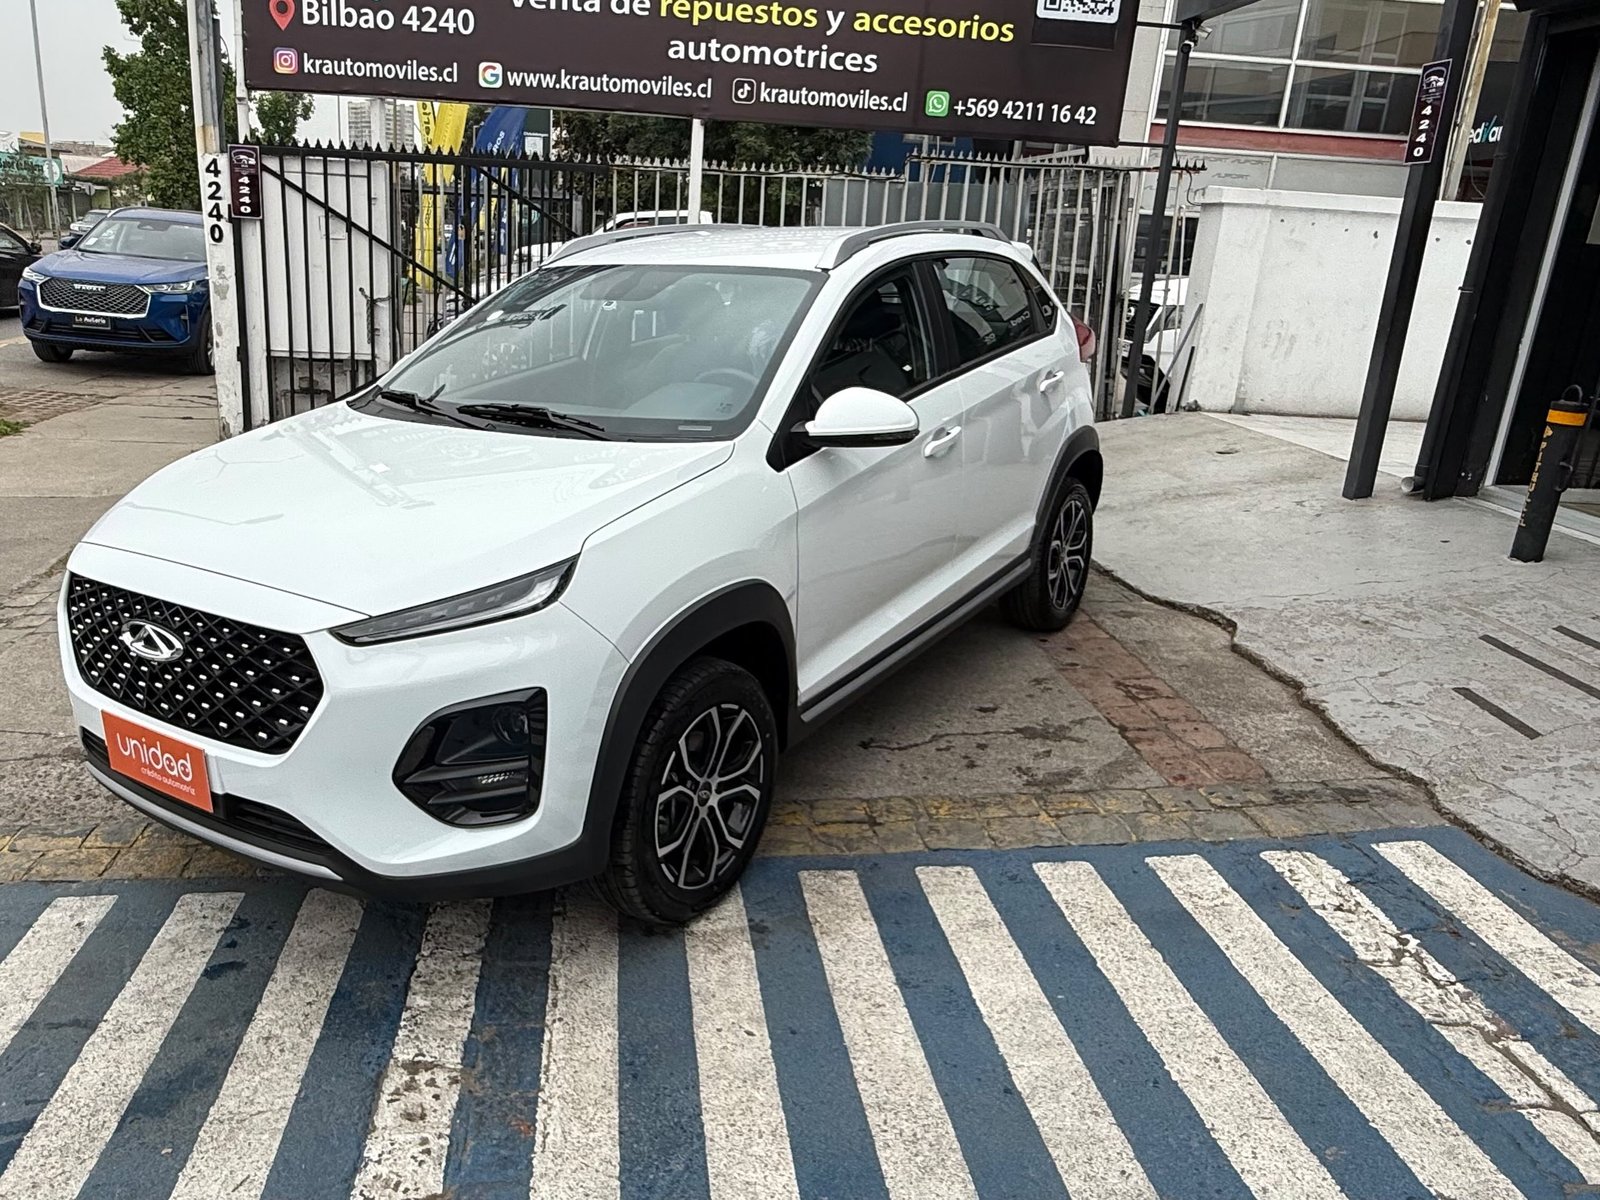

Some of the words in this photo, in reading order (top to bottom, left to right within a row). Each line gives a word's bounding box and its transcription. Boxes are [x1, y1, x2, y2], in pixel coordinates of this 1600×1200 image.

[302, 0, 395, 31] Bilbao
[402, 5, 475, 36] 4240
[660, 0, 818, 27] repuestos
[826, 9, 845, 36] y
[853, 12, 1015, 42] accesorios
[303, 53, 458, 83] krautomoviles.cl
[668, 38, 878, 73] automotrices
[507, 69, 712, 98] www.krautomoviles.cl
[760, 82, 908, 112] krautomoviles.cl
[953, 98, 999, 119] +569
[1002, 101, 1044, 121] 4211
[1051, 104, 1071, 124] 16
[1074, 106, 1097, 125] 42
[1413, 105, 1432, 157] 4240
[205, 157, 225, 243] 4240
[238, 176, 251, 213] 4240
[116, 732, 193, 782] unidad
